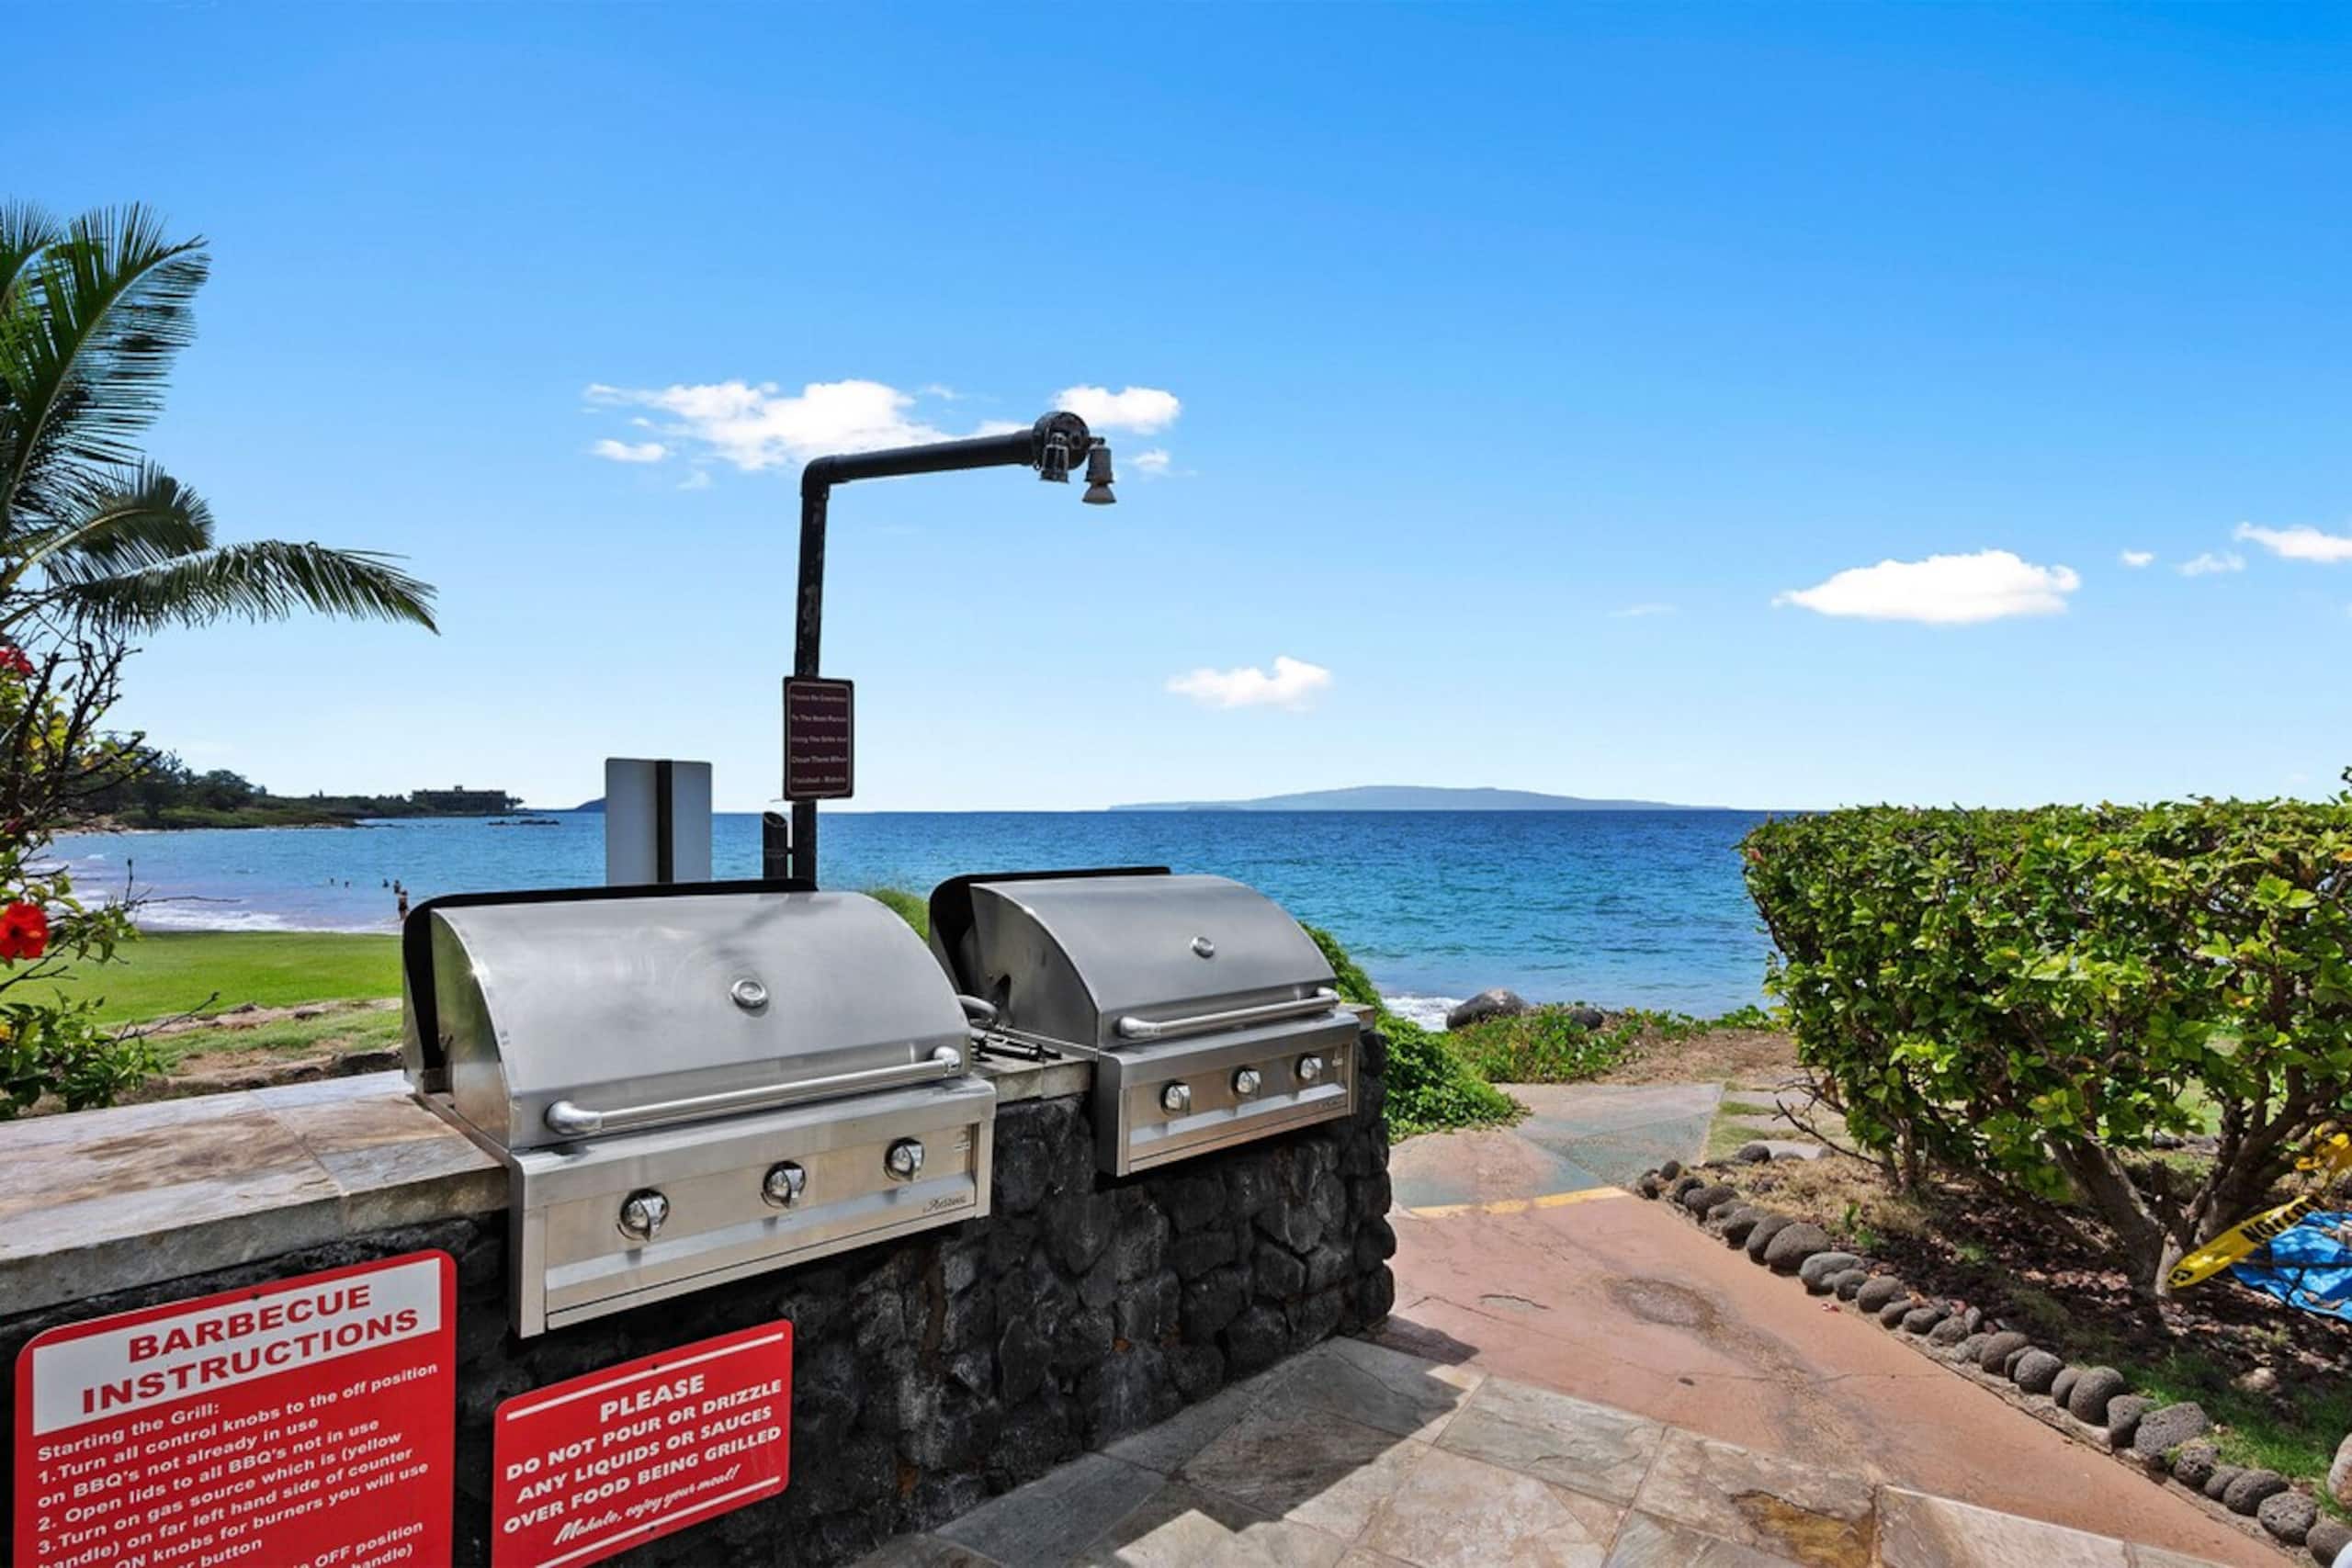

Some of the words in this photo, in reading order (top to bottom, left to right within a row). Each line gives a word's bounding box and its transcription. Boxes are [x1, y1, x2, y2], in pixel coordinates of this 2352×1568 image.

[82, 1308, 418, 1414] INSTRUCTIONS
[129, 1285, 370, 1362] BARBECUE
[38, 1429, 124, 1461] Starting
[132, 1418, 164, 1436] the
[171, 1402, 220, 1424] Grill:
[114, 1446, 138, 1463] all
[145, 1424, 217, 1454] control
[223, 1409, 280, 1432] knobs
[287, 1402, 304, 1415] to
[309, 1392, 338, 1408] the
[343, 1382, 366, 1398] off
[371, 1363, 437, 1393] position
[506, 1457, 540, 1481] DO
[548, 1438, 596, 1466] NOT
[602, 1416, 662, 1448] POUR
[667, 1405, 696, 1426] OR
[702, 1380, 782, 1415] DRIZZLE
[600, 1374, 705, 1423] PLEASE
[38, 1490, 65, 1508] on
[74, 1470, 140, 1498] BBQ's
[147, 1457, 180, 1476] not
[187, 1434, 257, 1464] already
[263, 1427, 279, 1442] in
[287, 1418, 318, 1435] use
[38, 1516, 57, 1532] 2.
[64, 1497, 121, 1523] Open
[130, 1484, 166, 1504] lids
[173, 1477, 193, 1490] to
[198, 1466, 222, 1483] all
[229, 1448, 287, 1473] BBQ's
[293, 1438, 322, 1454] not
[327, 1430, 343, 1444] in
[349, 1420, 379, 1437] use
[114, 1516, 140, 1530] on
[147, 1501, 183, 1523] gas
[189, 1479, 255, 1507] source
[261, 1458, 314, 1484] which
[320, 1451, 336, 1466] is
[342, 1432, 401, 1461] (yellow
[127, 1534, 153, 1549] on
[160, 1521, 187, 1538] far
[193, 1508, 224, 1527] left
[231, 1491, 277, 1516] hand
[283, 1478, 320, 1499] side
[325, 1470, 345, 1485] of
[347, 1448, 413, 1477] counter
[503, 1501, 564, 1534] OVER
[571, 1477, 631, 1509] FOOD
[638, 1453, 698, 1484] BEING
[704, 1426, 781, 1461] GRILLED
[516, 1472, 568, 1504] ANY
[575, 1441, 660, 1483] LIQUIDS
[665, 1430, 695, 1450] OR
[700, 1405, 772, 1439] SAUCES
[626, 1496, 662, 1517] enjoy
[663, 1484, 695, 1509] your
[114, 1554, 146, 1568] ON
[153, 1534, 213, 1562] knobs
[220, 1523, 247, 1540] for
[254, 1497, 323, 1529] burners
[329, 1486, 360, 1506] you
[366, 1472, 395, 1492] will
[399, 1462, 428, 1481] use
[200, 1539, 262, 1567] button
[314, 1545, 351, 1567] OFF
[356, 1521, 424, 1556] position
